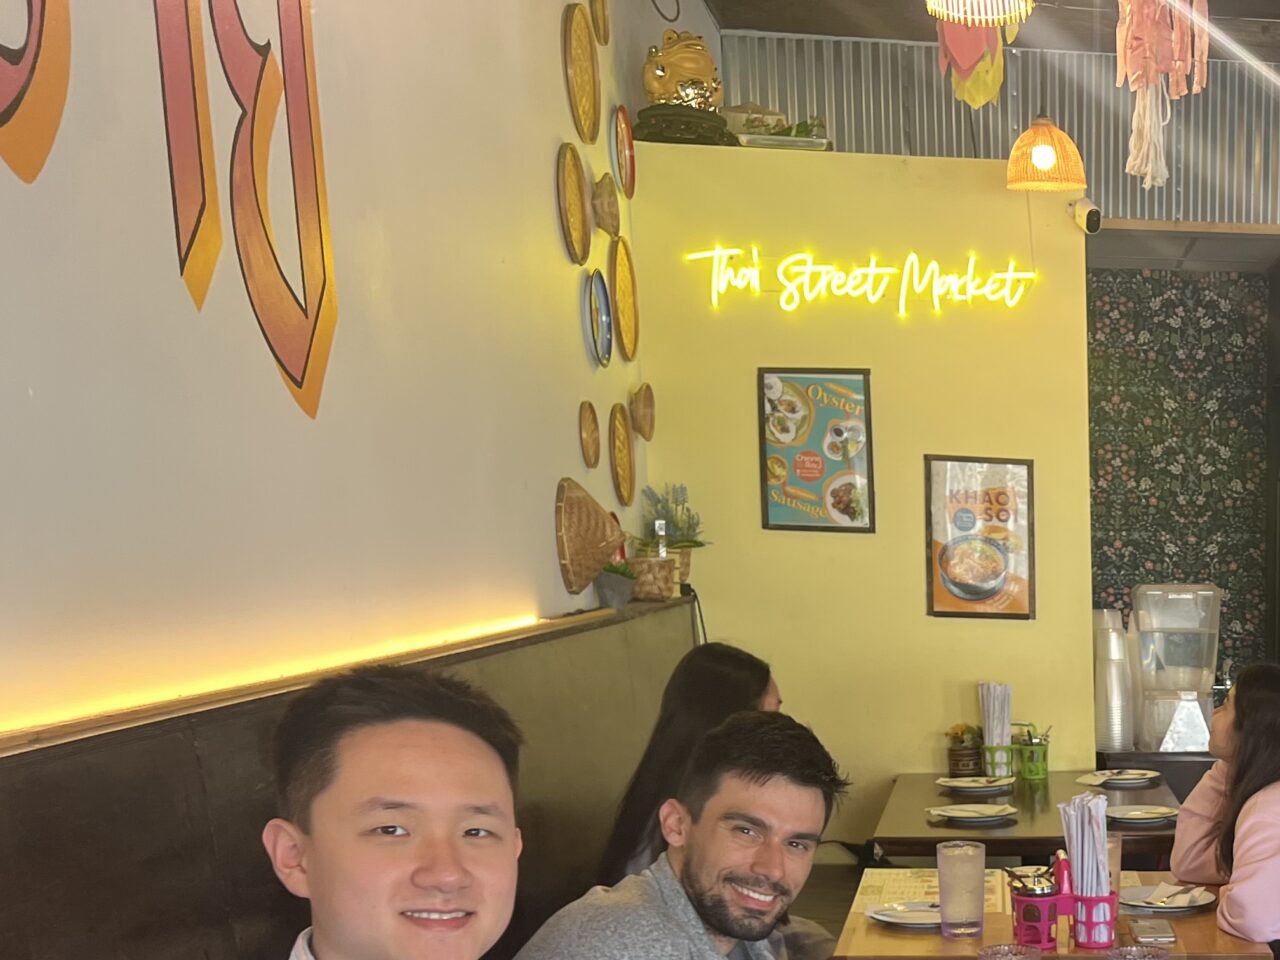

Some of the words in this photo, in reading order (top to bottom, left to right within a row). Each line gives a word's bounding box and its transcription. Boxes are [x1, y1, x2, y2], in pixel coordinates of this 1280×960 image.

[686, 246, 761, 307] Thai
[777, 252, 899, 312] Street
[897, 251, 1036, 318] Market
[806, 384, 864, 416] Oyster
[770, 489, 827, 518] Sausage
[949, 488, 1010, 507] KHAO
